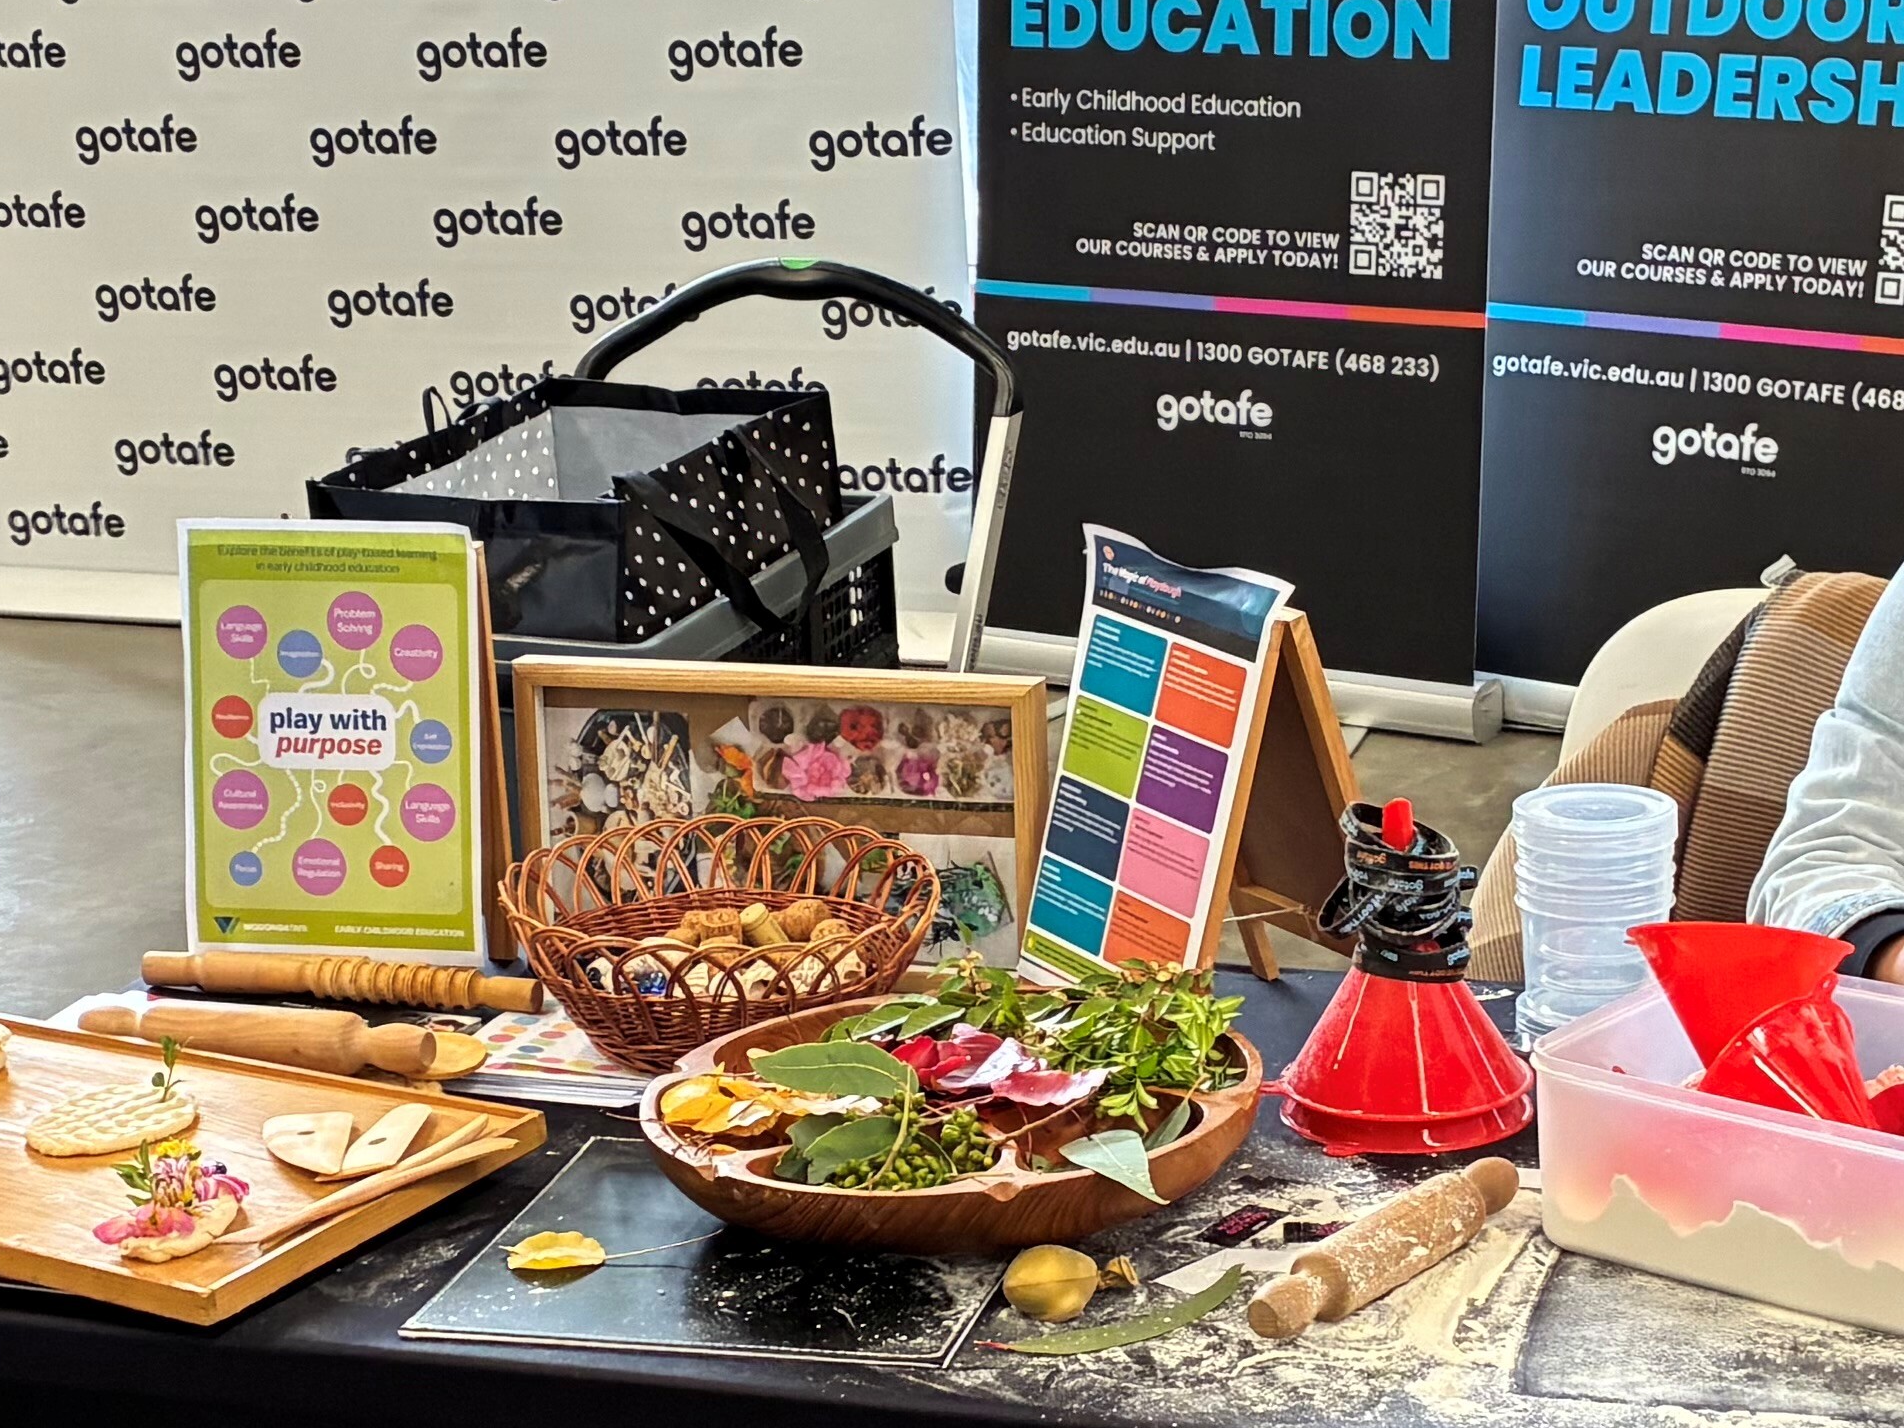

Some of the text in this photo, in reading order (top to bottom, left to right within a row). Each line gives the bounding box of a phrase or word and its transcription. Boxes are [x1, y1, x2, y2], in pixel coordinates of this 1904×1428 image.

[1022, 87, 1301, 118] Early Childhood Education
[310, 115, 437, 167] gotafe
[1022, 122, 1215, 154] Education Support
[1134, 222, 1340, 249] SCAN QR CODE TO VIEW
[1076, 238, 1338, 269] OUR COURSES & APPLY TODAY!
[1642, 244, 1867, 277] SCAN QR CODE TO VIEW
[1577, 259, 1864, 298] OUR COURSES & APPLY TODAY!
[1007, 330, 1180, 358] gotafe.vic.edu.au
[1197, 342, 1242, 363] 1300
[1248, 347, 1328, 369] GOTAFE
[1336, 348, 1385, 375] (468
[1391, 354, 1439, 382] 233)
[1492, 355, 1684, 388] gotafe.vic.edu.au
[1703, 371, 1751, 394] 1300
[1757, 378, 1845, 404] GOTAFE
[1157, 389, 1273, 431] gotafe
[1652, 423, 1778, 465] gotafe
[9, 501, 124, 545] gotafe
[334, 608, 376, 620] Problem
[337, 622, 373, 635] Solving
[270, 708, 387, 733] play with
[276, 735, 382, 759] purpose
